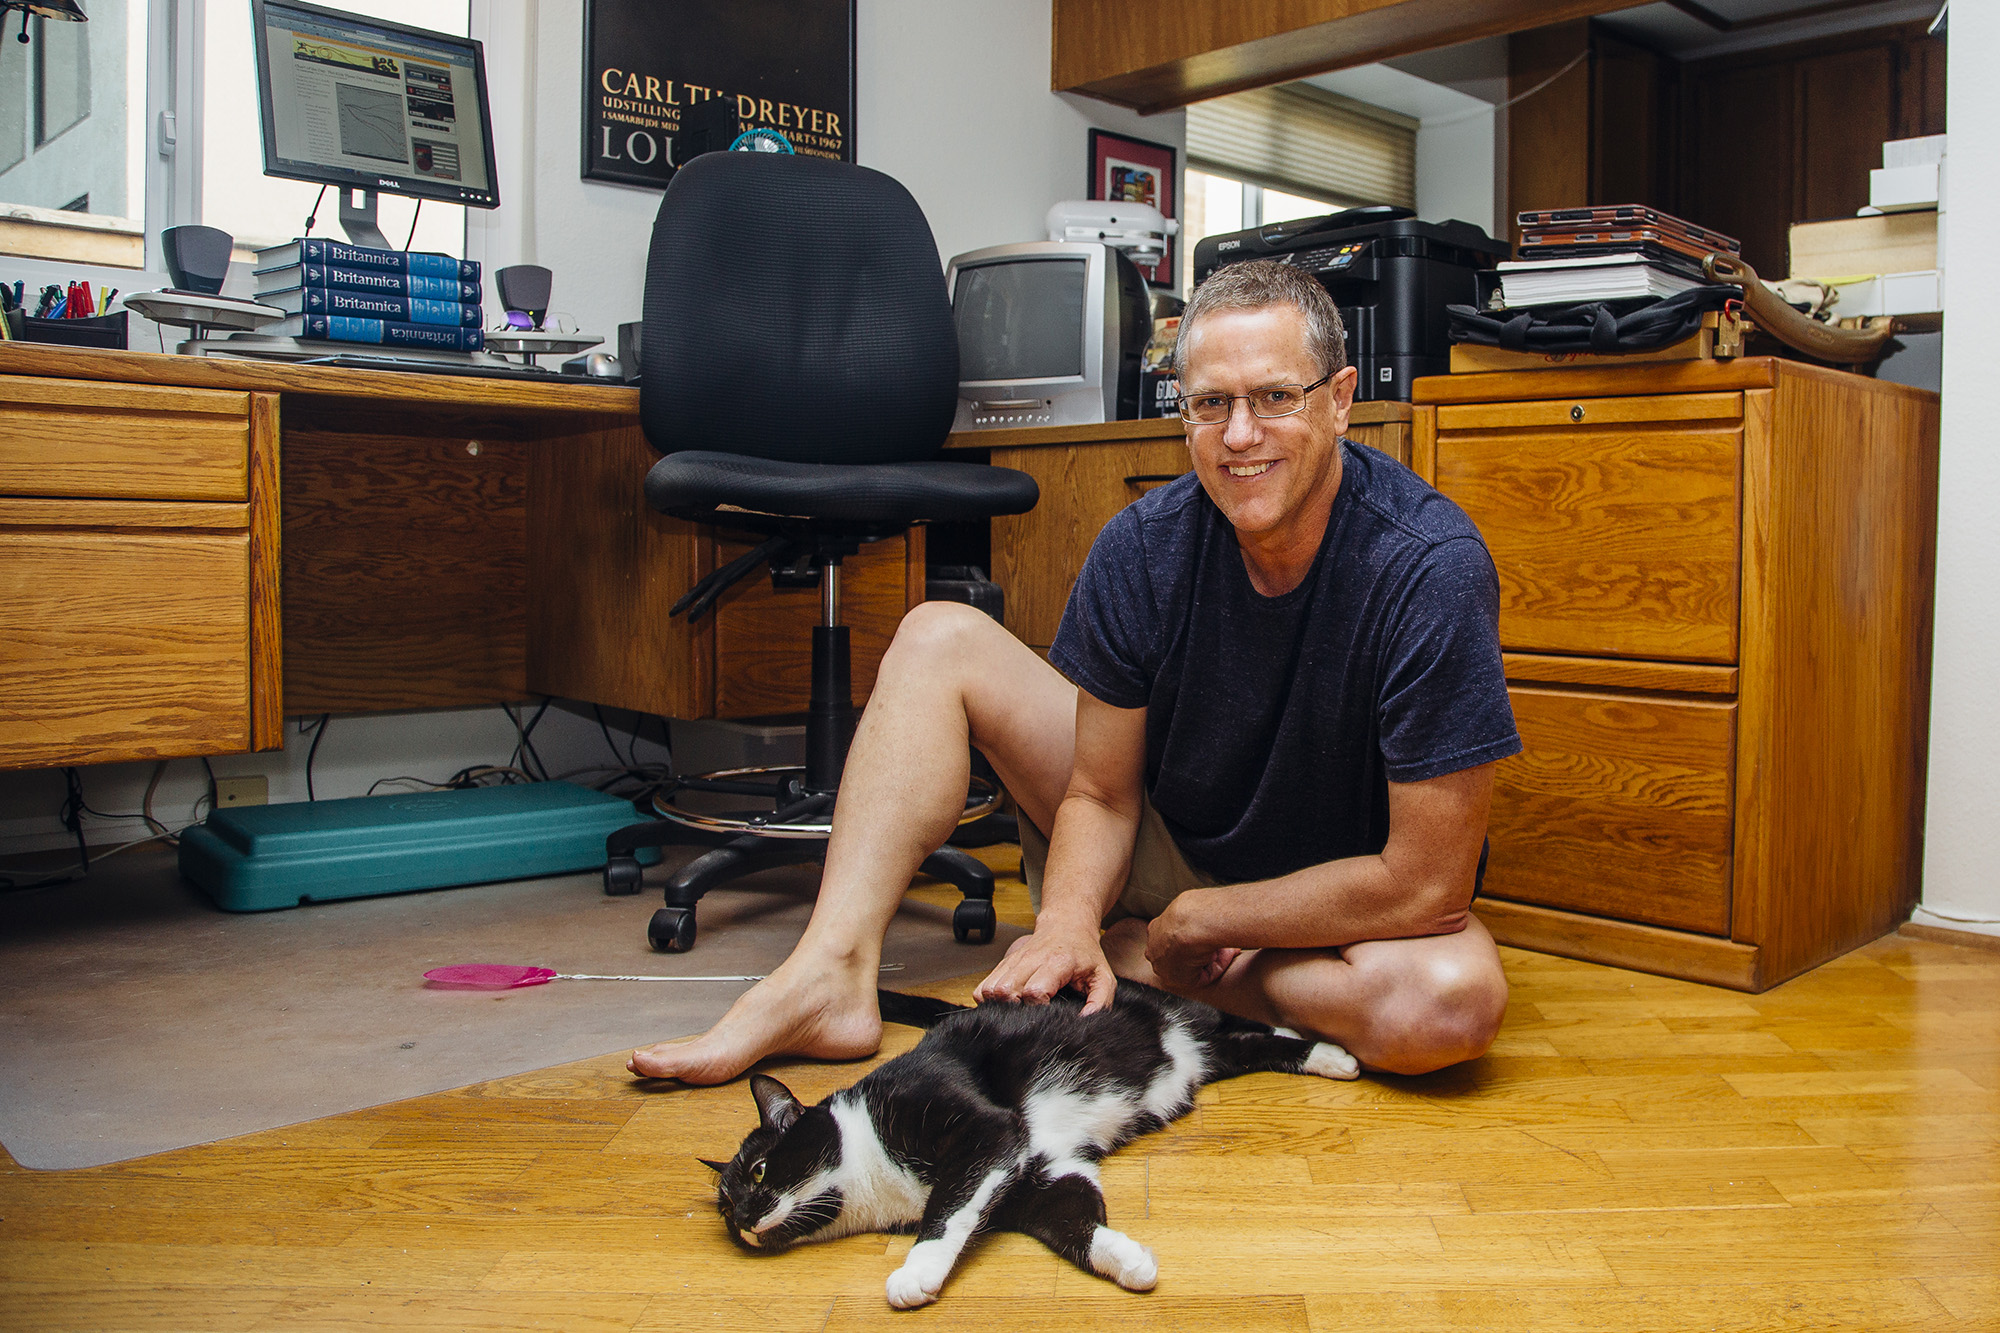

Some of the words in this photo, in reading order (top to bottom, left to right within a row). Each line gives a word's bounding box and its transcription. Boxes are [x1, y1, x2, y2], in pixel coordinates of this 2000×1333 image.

[601, 67, 680, 106] CARL
[736, 93, 842, 137] DREYER
[603, 96, 681, 120] UDSTILLING
[778, 128, 817, 145] MARTS
[819, 136, 842, 150] 1967
[607, 111, 659, 128] SAMARBEJDE
[661, 121, 680, 132] MED
[378, 179, 401, 189] DELL
[1218, 239, 1241, 251] EPSON
[332, 246, 400, 267] Britannica
[333, 269, 401, 289] Britannica
[334, 295, 401, 313] Britannica
[391, 328, 456, 344] Britannica
